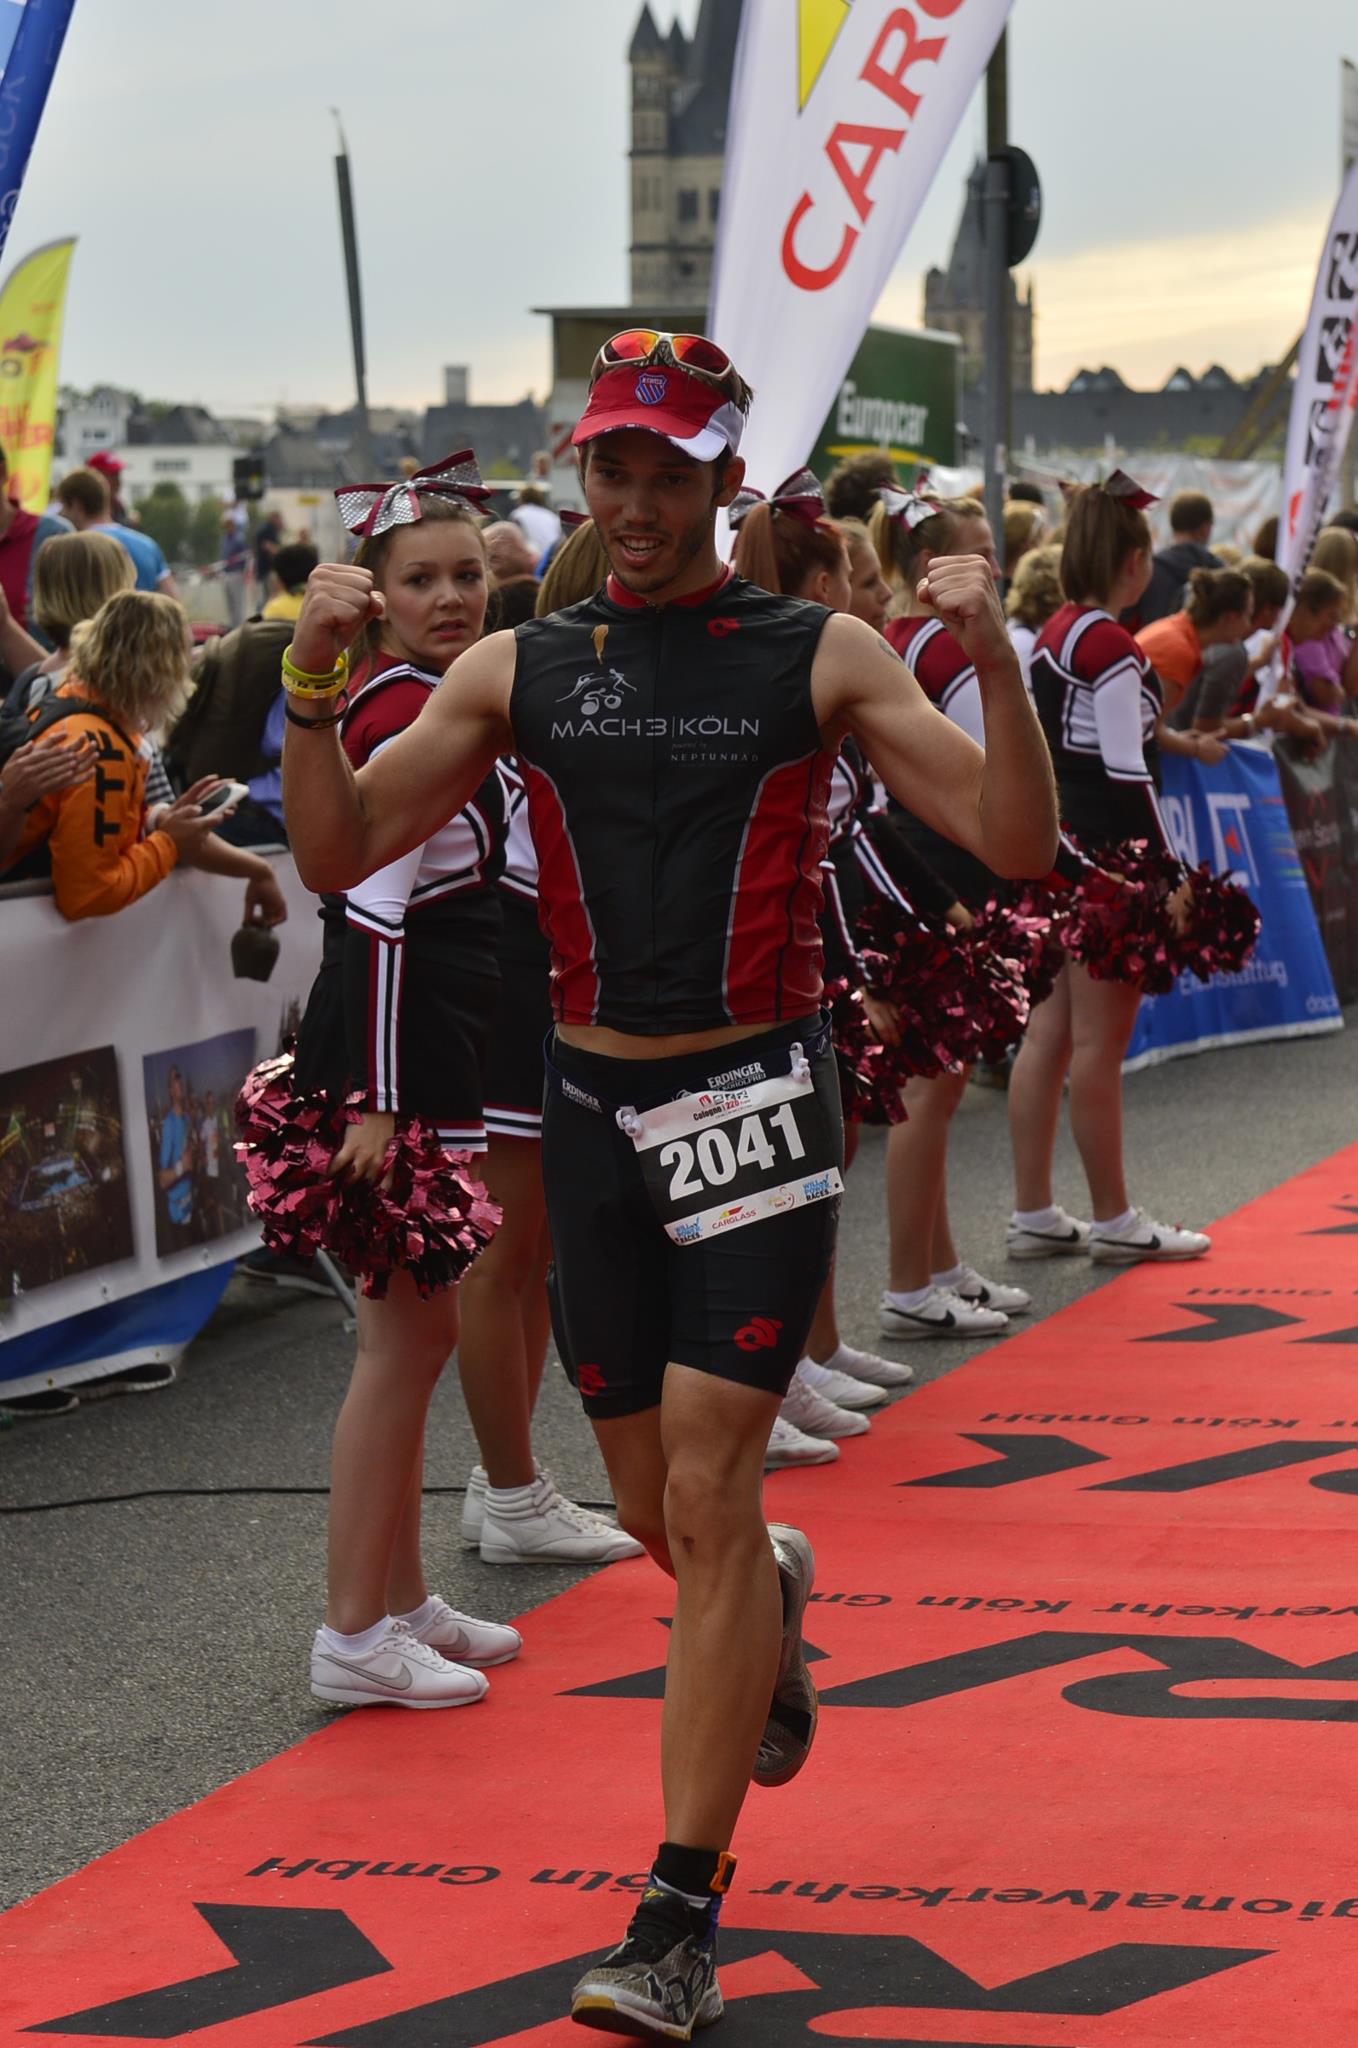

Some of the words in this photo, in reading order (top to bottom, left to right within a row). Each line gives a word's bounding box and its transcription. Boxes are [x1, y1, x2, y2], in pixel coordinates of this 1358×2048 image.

[780, 0, 967, 292] CAR
[836, 379, 929, 452] Europcar
[679, 715, 760, 737] KÖLN
[706, 1061, 765, 1090] ERDINGER
[561, 1077, 600, 1108] ERDINGER
[693, 1107, 723, 1122] Cologne
[659, 1103, 806, 1201] 2041
[712, 1209, 757, 1230] CARGLASS
[979, 1412, 1150, 1426] GmbH
[917, 1595, 1073, 1615] Köln
[245, 1856, 502, 1886] GmbH
